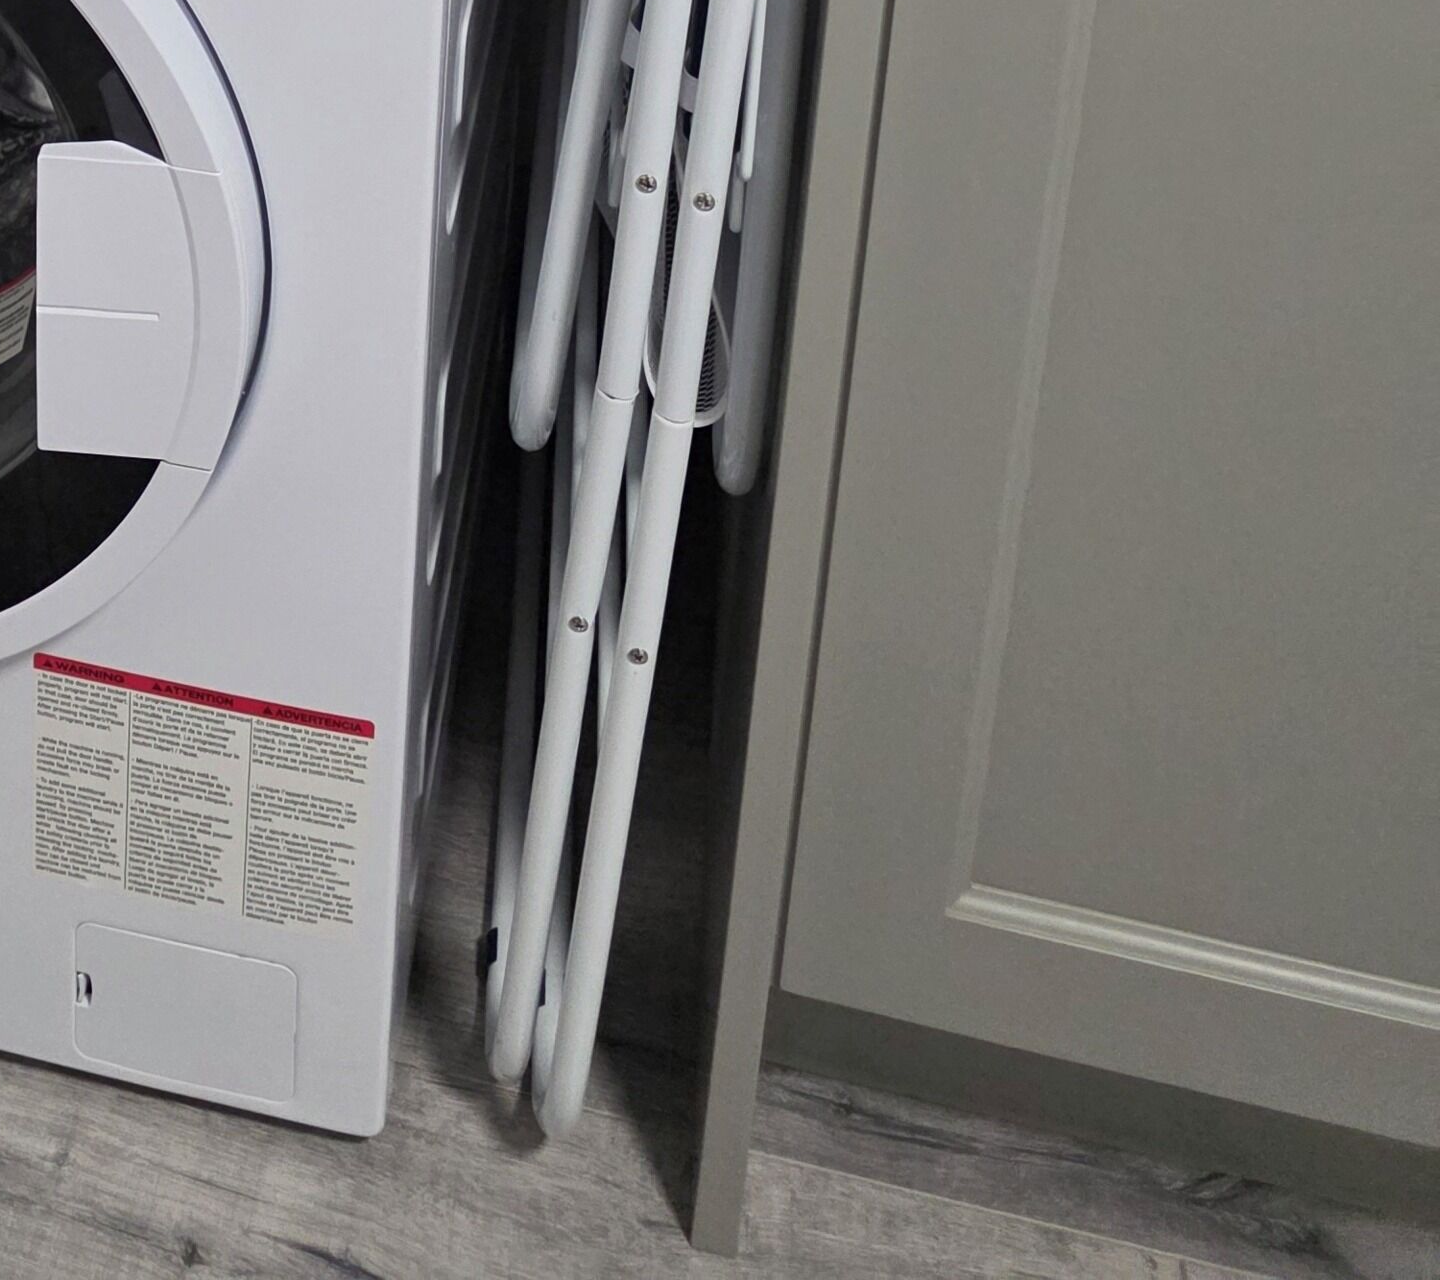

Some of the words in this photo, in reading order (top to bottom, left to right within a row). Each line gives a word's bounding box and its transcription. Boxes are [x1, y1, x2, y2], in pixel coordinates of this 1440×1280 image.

[56, 661, 125, 683] WARNING
[165, 684, 233, 707] ATTENTION
[277, 709, 362, 732] ADVERTENCIA
